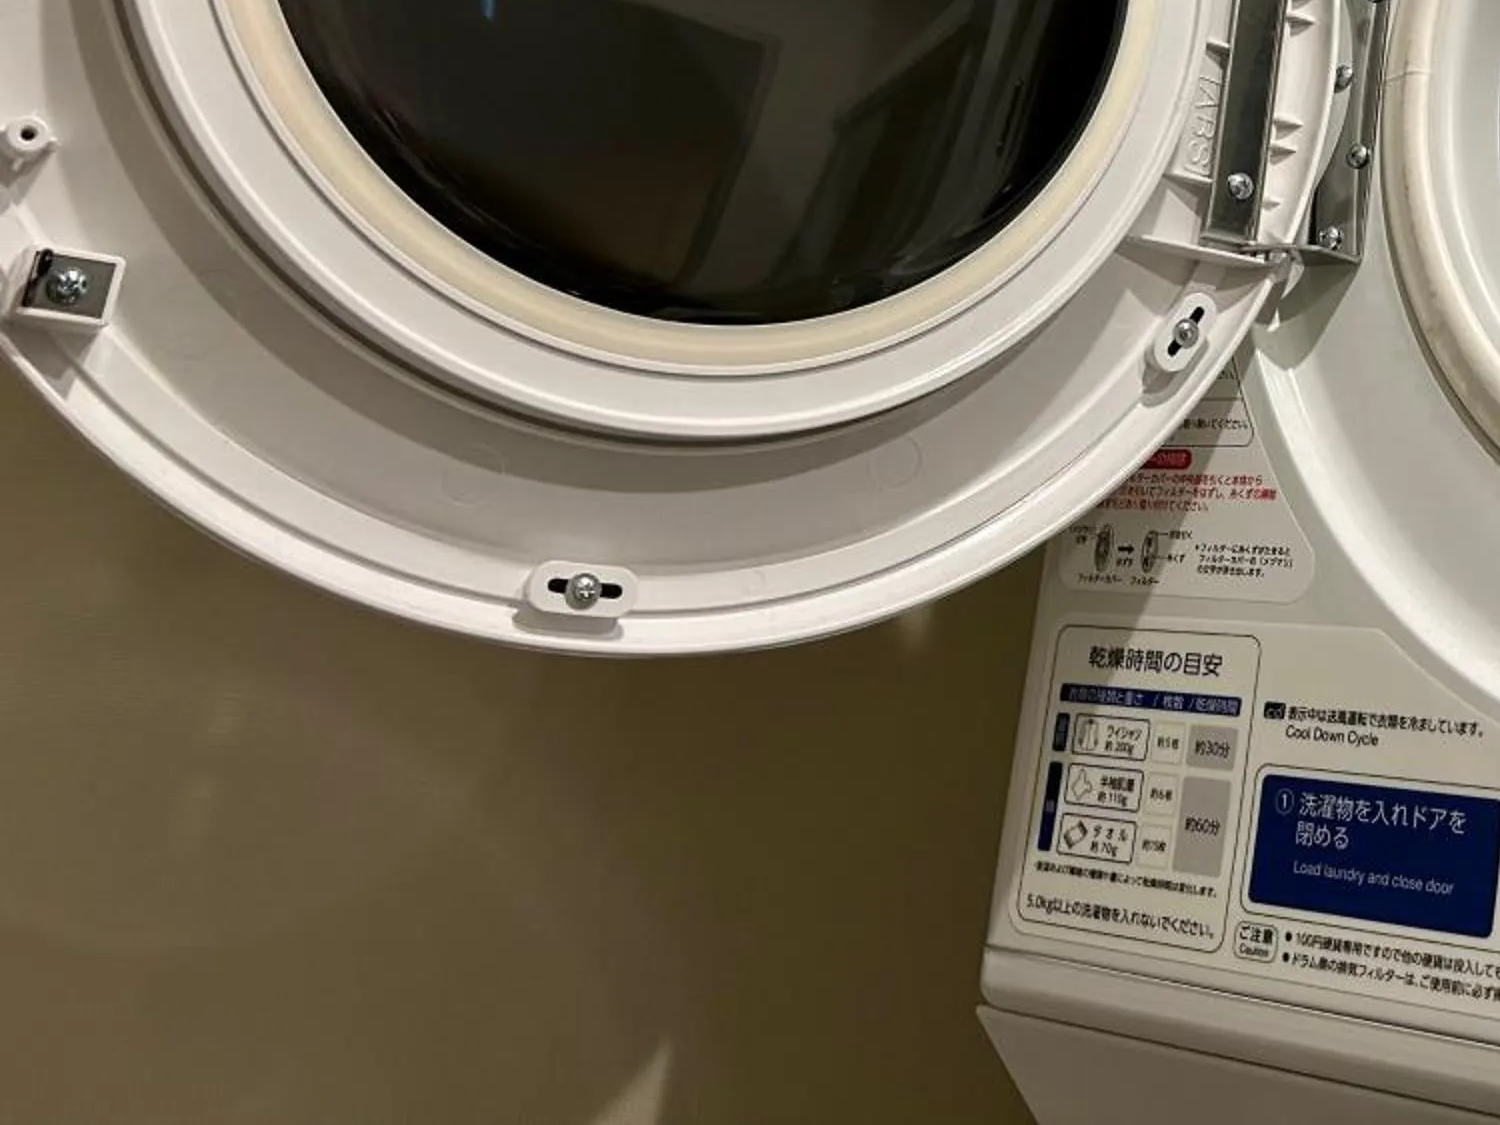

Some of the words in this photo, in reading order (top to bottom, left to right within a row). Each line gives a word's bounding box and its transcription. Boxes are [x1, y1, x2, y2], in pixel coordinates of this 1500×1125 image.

[1088, 645, 1223, 676] 乾燥時間の目安
[1285, 725, 1311, 740] Cool
[1313, 727, 1345, 744] Down
[1347, 731, 1379, 747] Cycle
[1295, 820, 1350, 850] 閉める
[1293, 859, 1321, 875] Load
[1324, 863, 1365, 885] laundry
[1367, 870, 1389, 886] and
[1391, 874, 1423, 892] close
[1425, 878, 1455, 895] door
